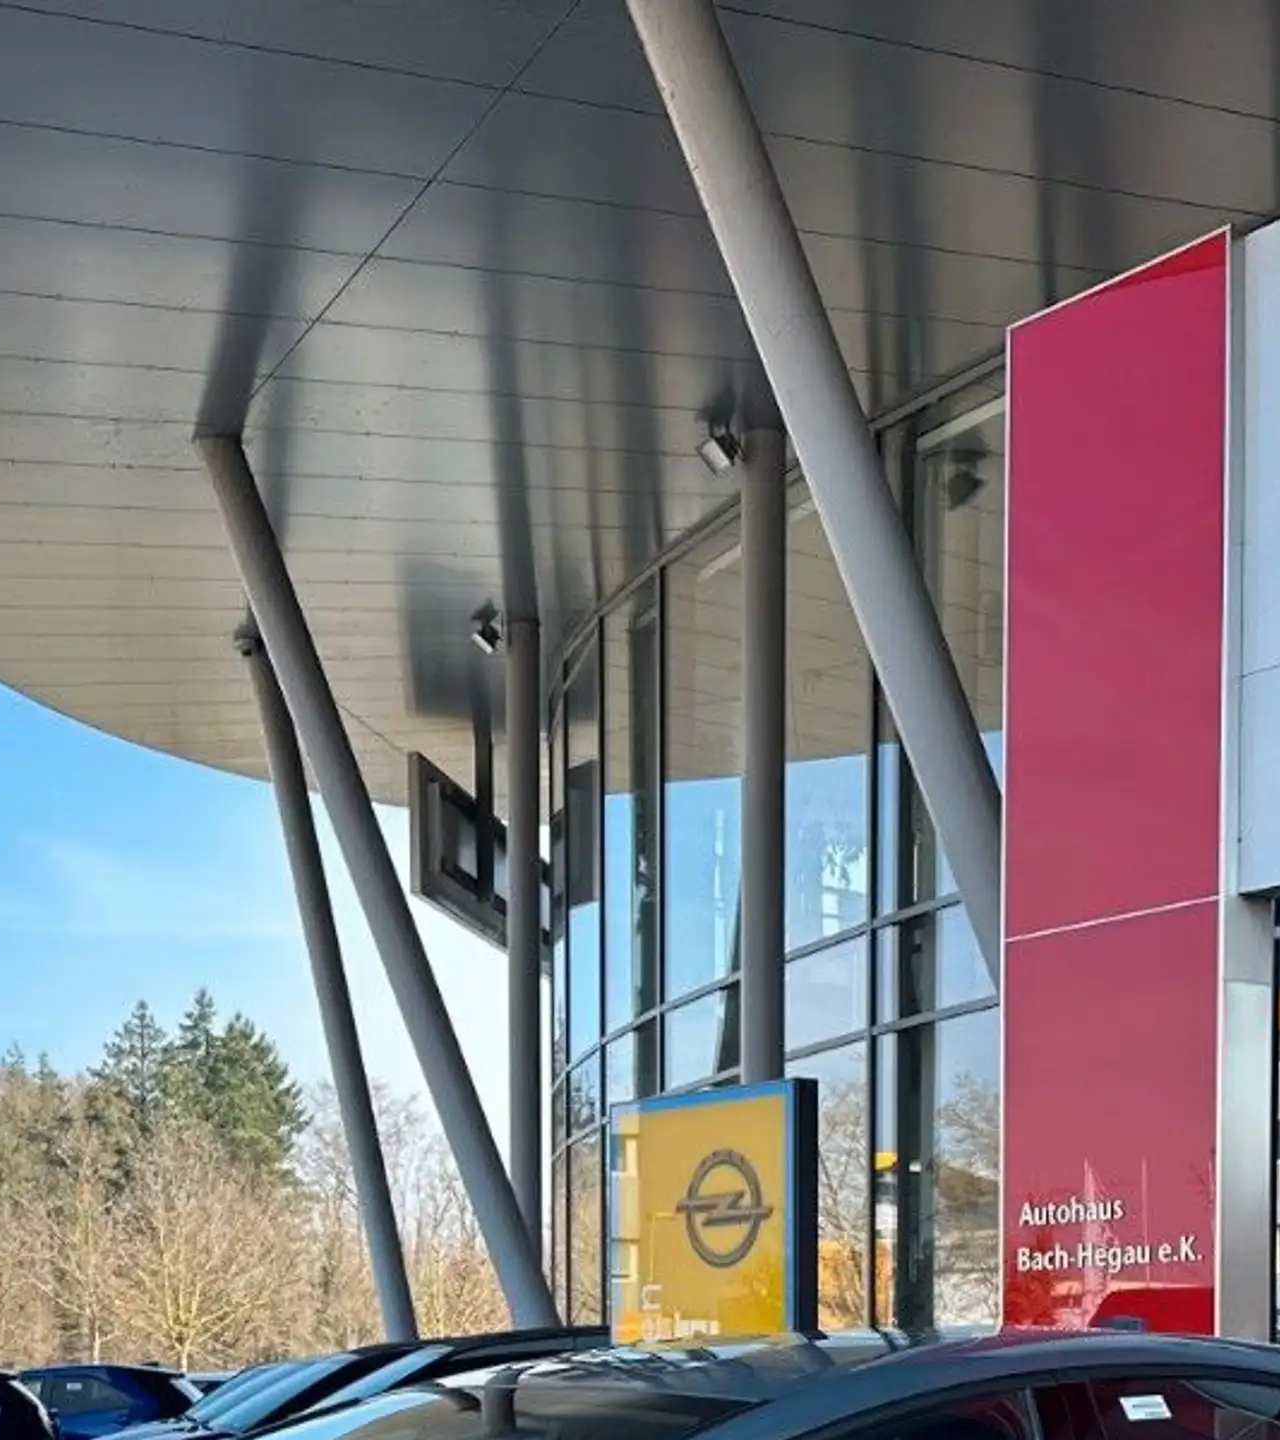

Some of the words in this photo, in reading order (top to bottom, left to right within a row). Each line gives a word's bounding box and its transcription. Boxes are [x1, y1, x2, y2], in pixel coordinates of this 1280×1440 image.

[1019, 1197, 1124, 1226] Autohaus
[1017, 1239, 1150, 1273] Bach-Hegau
[1158, 1235, 1204, 1262] e.K.
